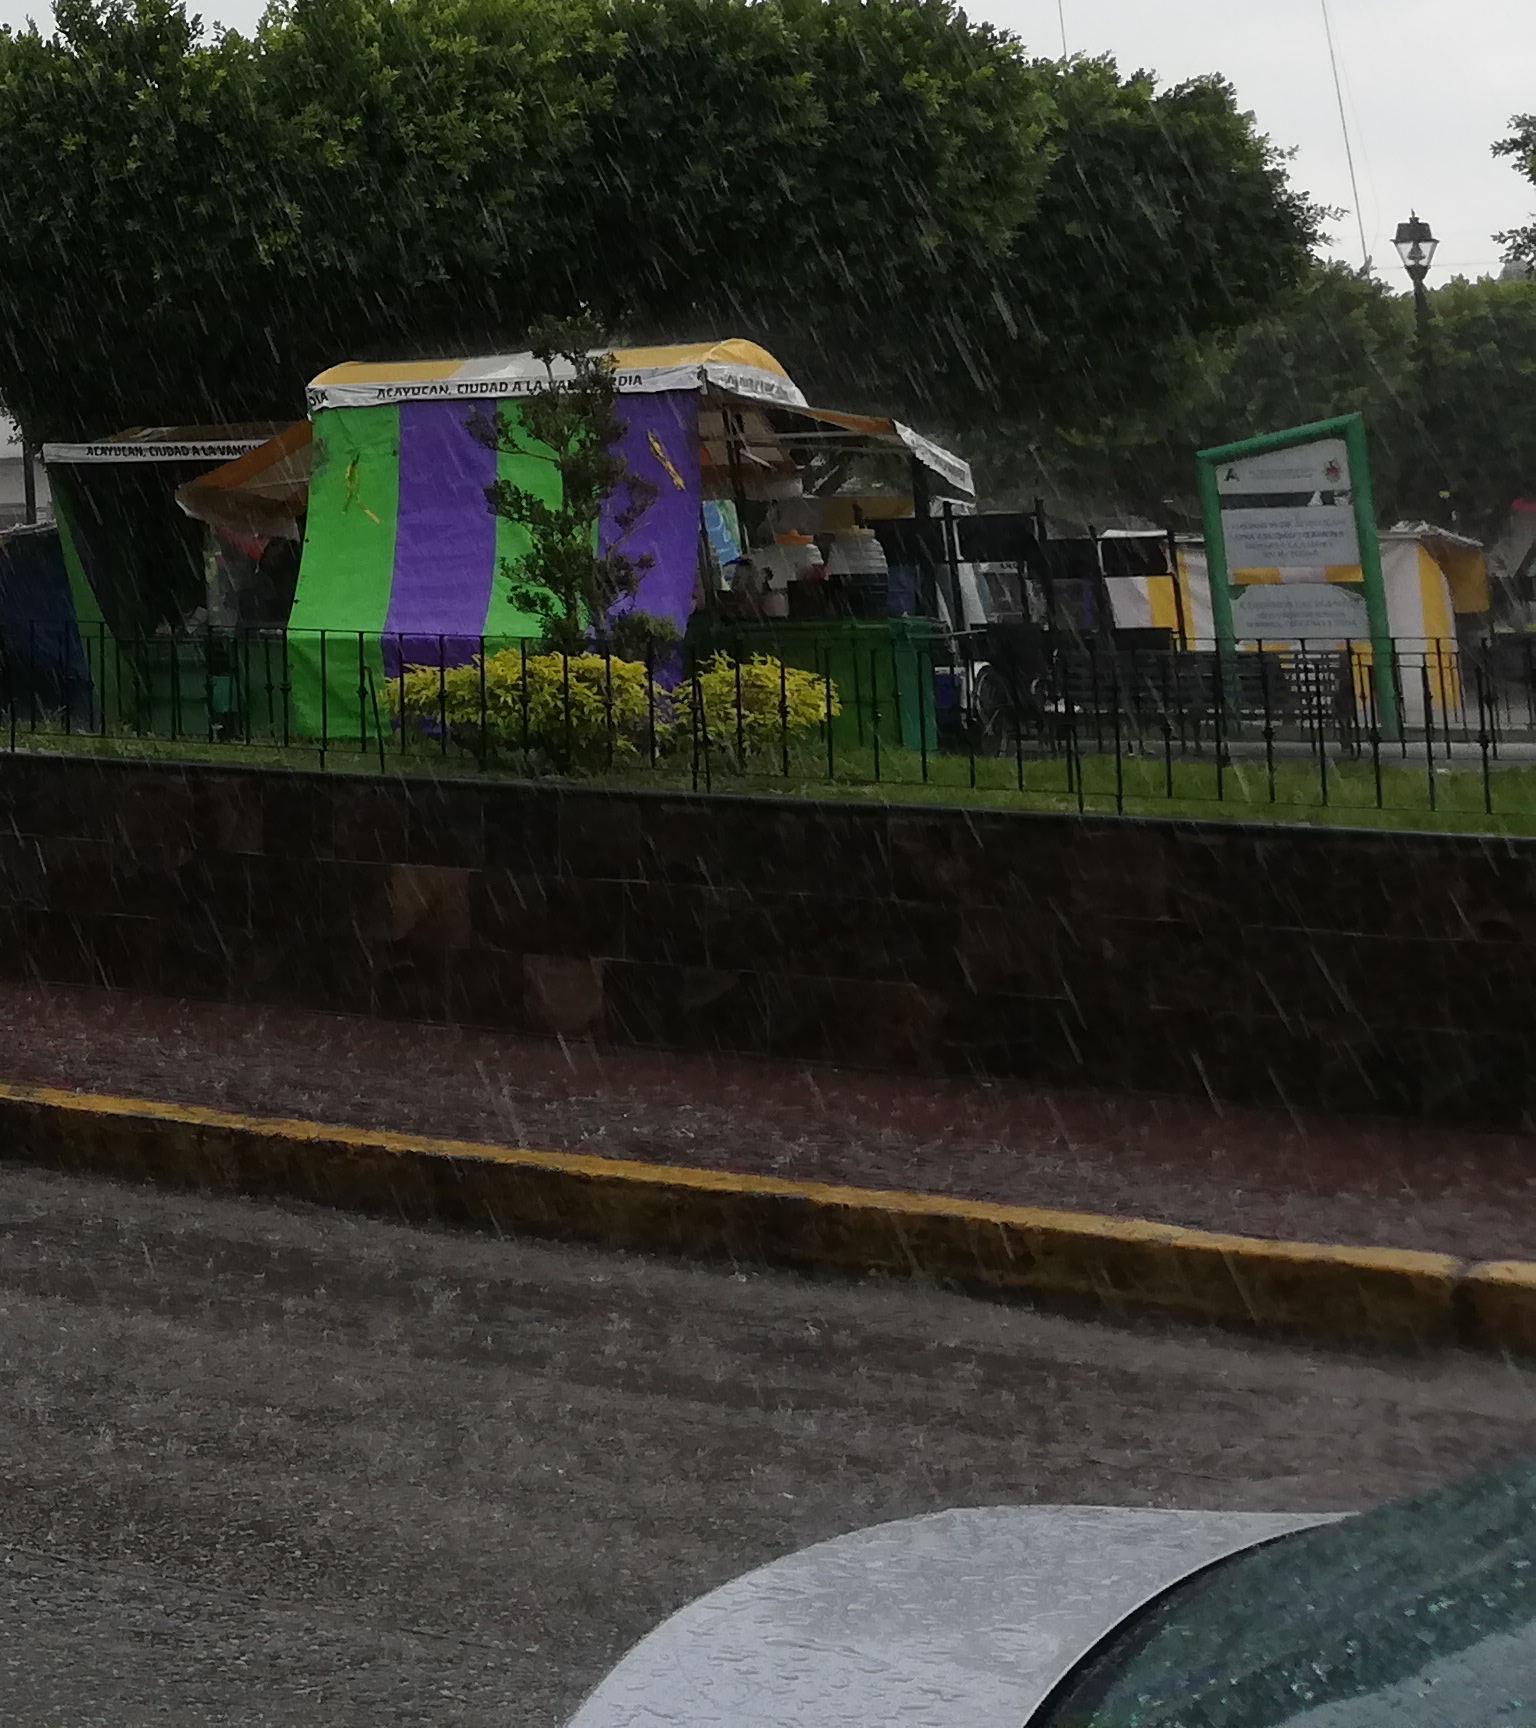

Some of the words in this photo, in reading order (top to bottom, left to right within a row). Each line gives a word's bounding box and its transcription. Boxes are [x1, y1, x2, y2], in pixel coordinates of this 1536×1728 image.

[457, 381, 509, 394] CIUDAD
[512, 381, 522, 393] A
[526, 380, 543, 392] LA
[148, 445, 190, 457] CIUDAD
[191, 445, 201, 456] A
